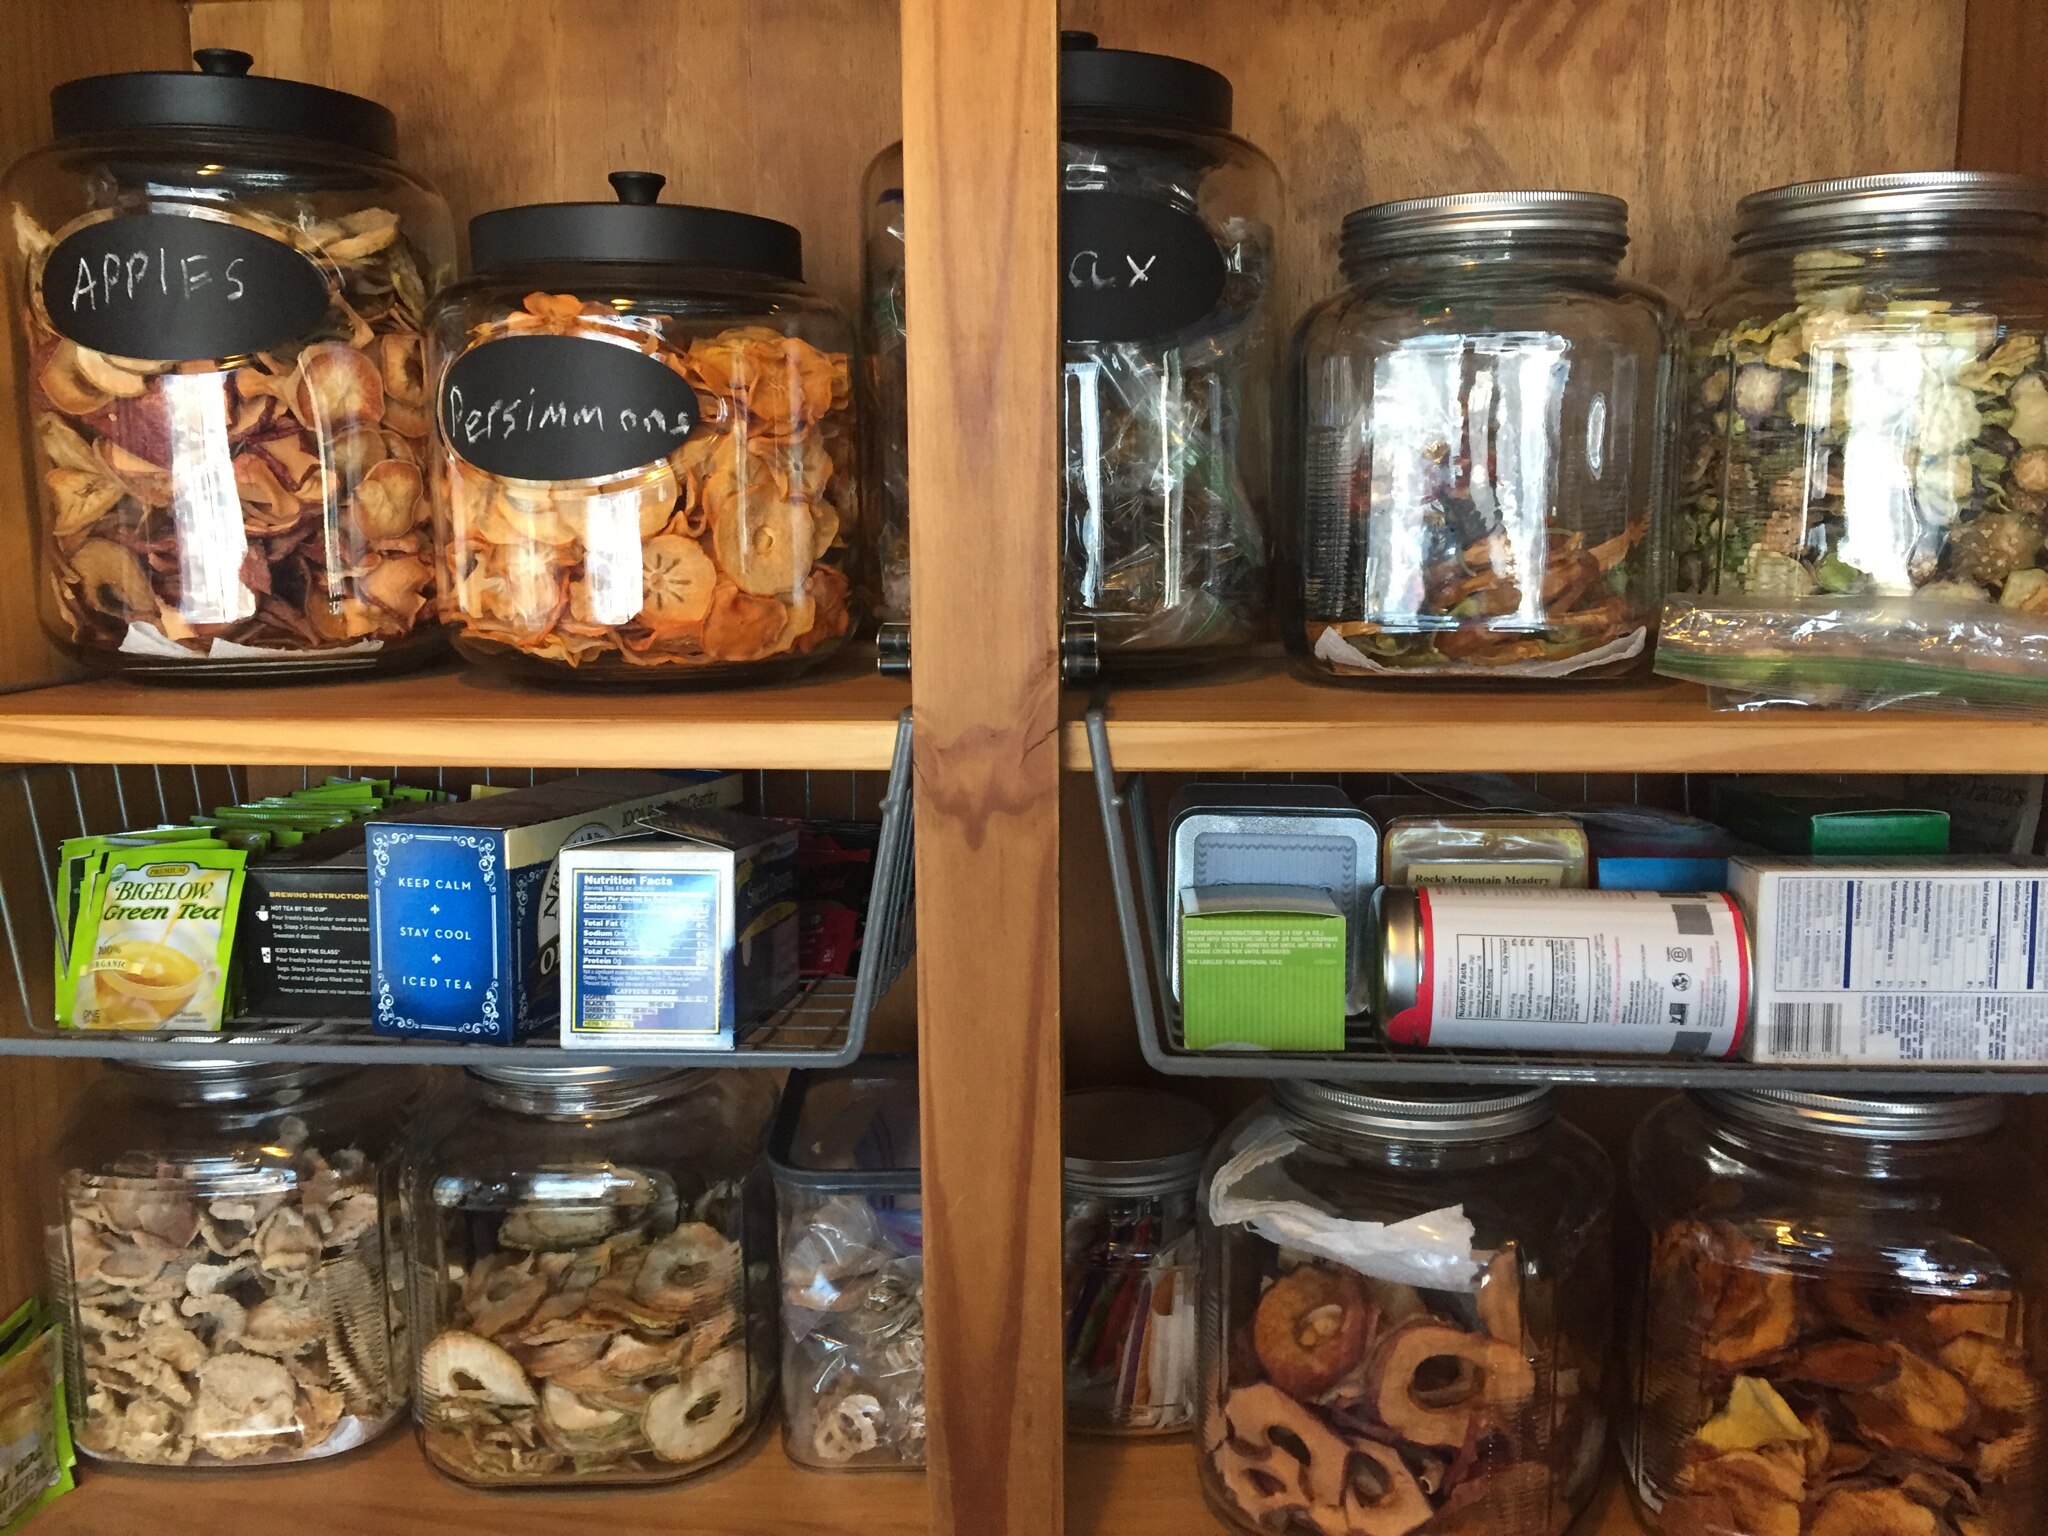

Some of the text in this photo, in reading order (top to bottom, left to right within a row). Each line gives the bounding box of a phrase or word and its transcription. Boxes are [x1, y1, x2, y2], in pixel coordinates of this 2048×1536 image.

[149, 866, 186, 875] PREMIUM
[398, 877, 471, 890] KEEP CALM
[584, 875, 673, 886] Nutrition Facts
[1415, 874, 1550, 886] Rocky Mountain Meadery
[116, 881, 214, 901] BIGELOW
[269, 891, 308, 899] BREWING
[104, 903, 222, 920] Green Tea
[400, 926, 471, 940] STAY COOL
[92, 960, 127, 969] RGANIC
[613, 958, 621, 966] 0g
[402, 976, 472, 989] ICED TEA
[1459, 963, 1467, 1017] Nutrition Facts
